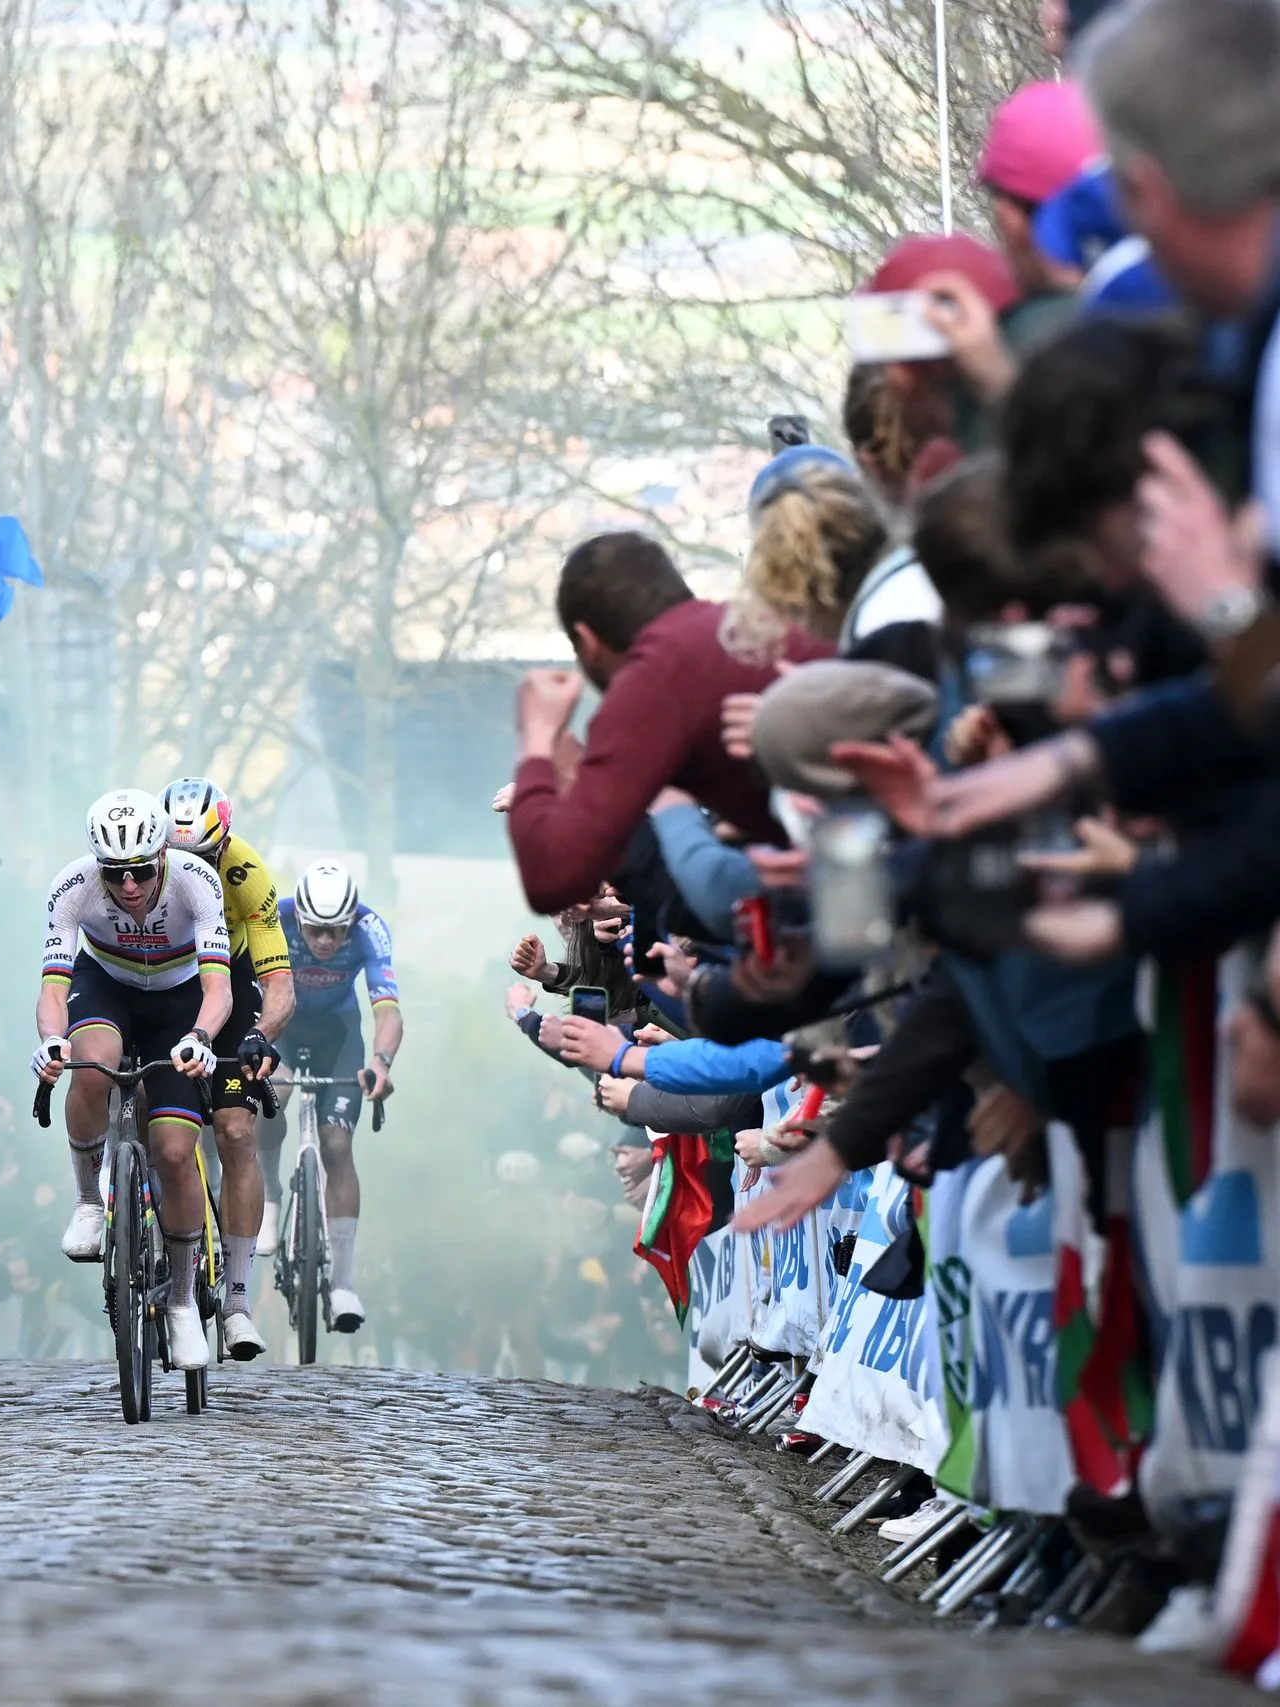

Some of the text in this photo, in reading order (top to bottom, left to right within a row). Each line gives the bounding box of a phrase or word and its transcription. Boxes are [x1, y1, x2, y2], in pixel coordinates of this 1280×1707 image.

[108, 807, 135, 821] G42
[51, 873, 85, 903] Analog
[191, 866, 222, 900] Analog
[203, 941, 230, 952] Emira
